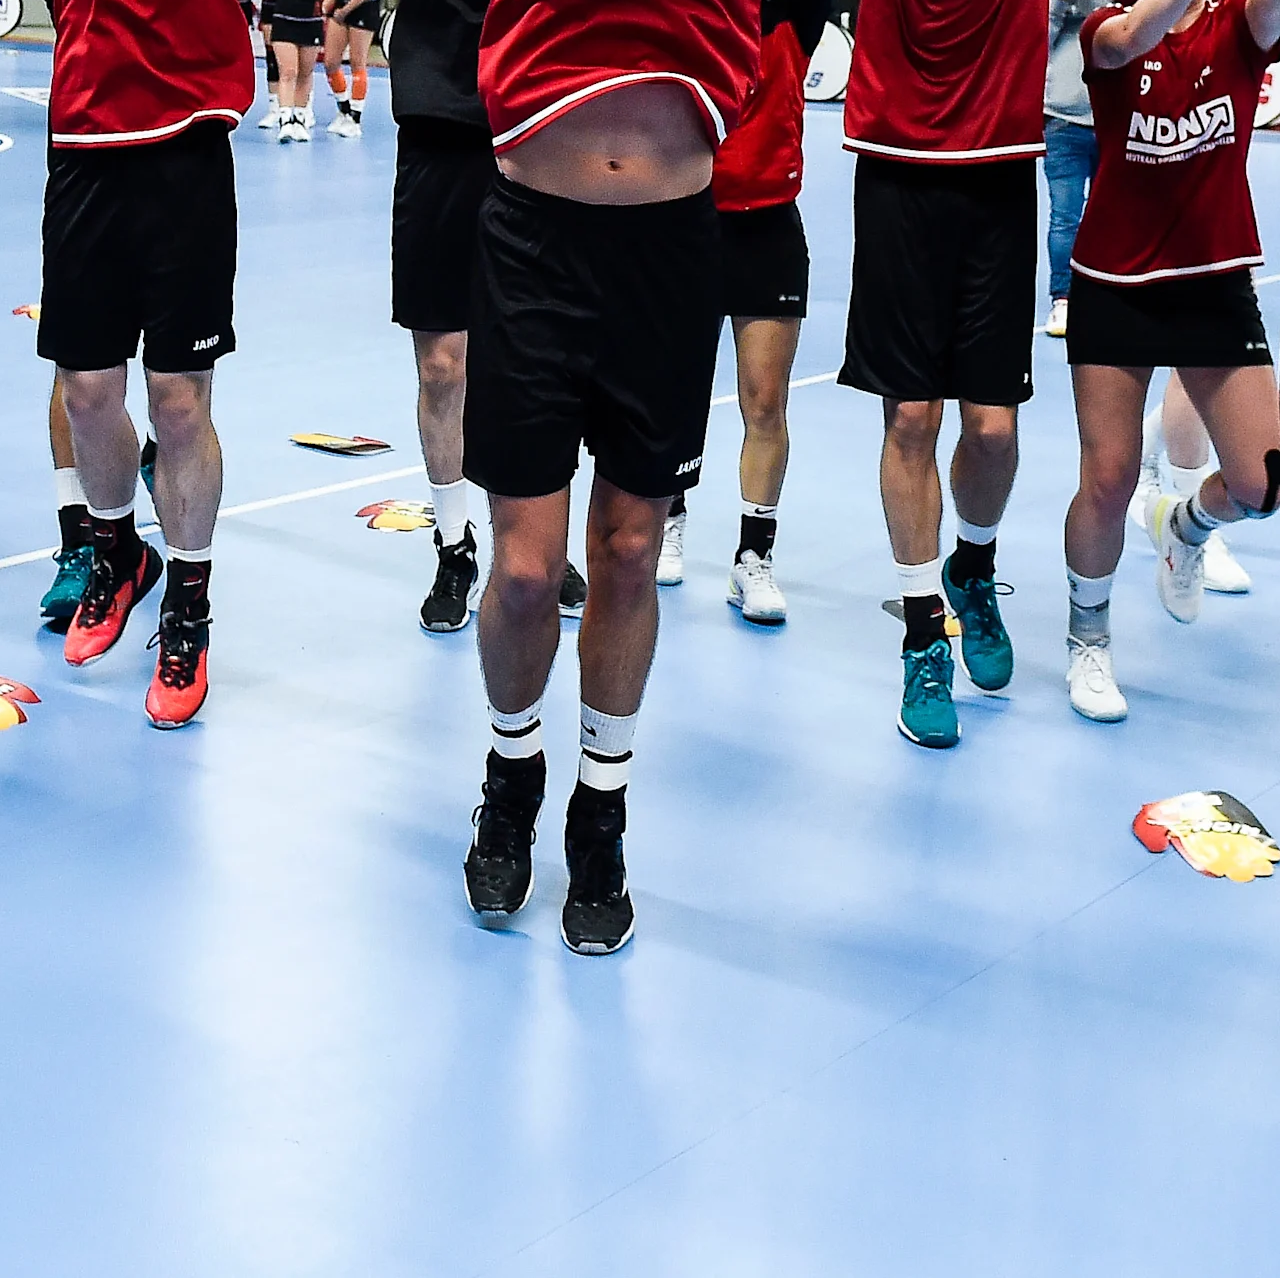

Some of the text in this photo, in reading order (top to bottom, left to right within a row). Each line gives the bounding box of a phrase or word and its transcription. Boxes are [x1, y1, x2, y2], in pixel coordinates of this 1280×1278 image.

[1140, 74, 1152, 96] 9
[1128, 110, 1203, 144] NDN
[192, 334, 220, 351] JAKO
